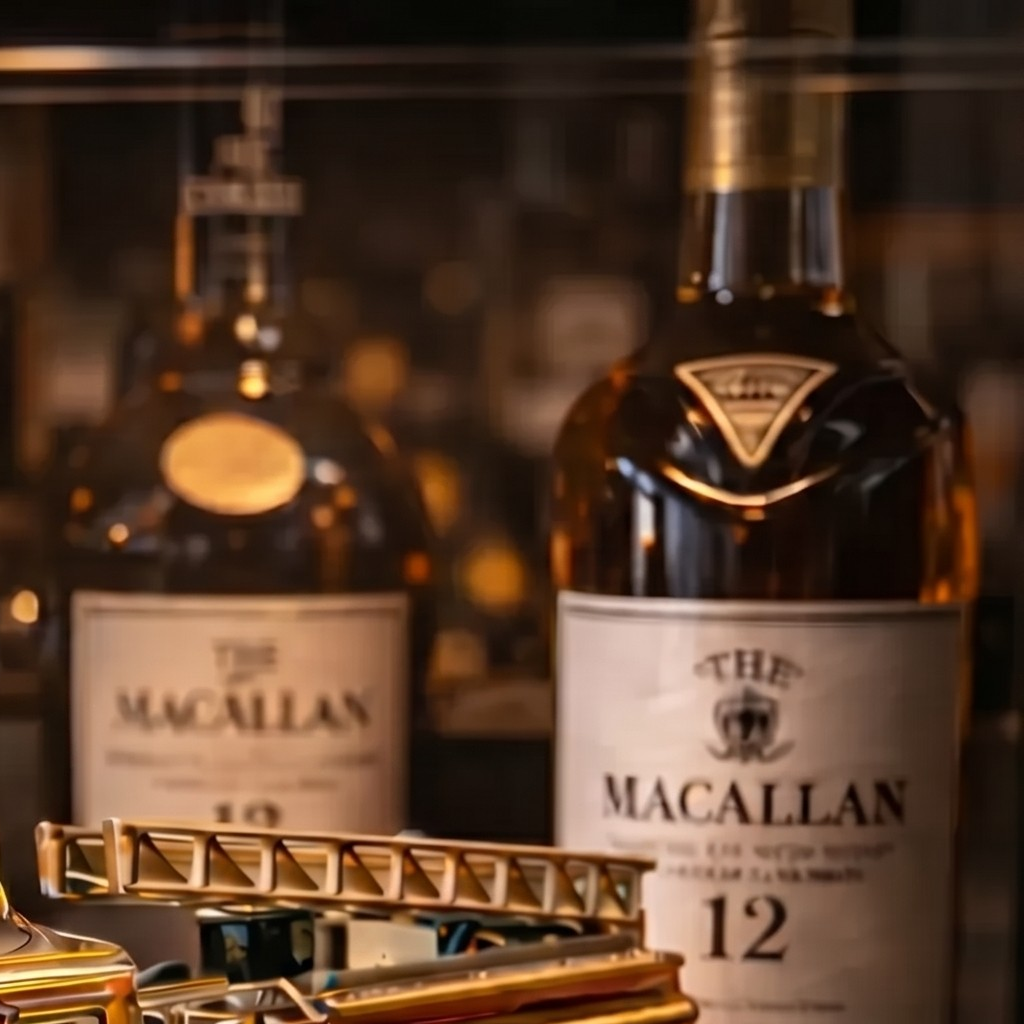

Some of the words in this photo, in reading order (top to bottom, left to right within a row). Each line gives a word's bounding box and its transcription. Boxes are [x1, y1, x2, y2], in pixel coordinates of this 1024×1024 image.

[702, 648, 796, 690] THE
[603, 771, 908, 827] MACALLAN
[702, 893, 791, 964] 12
